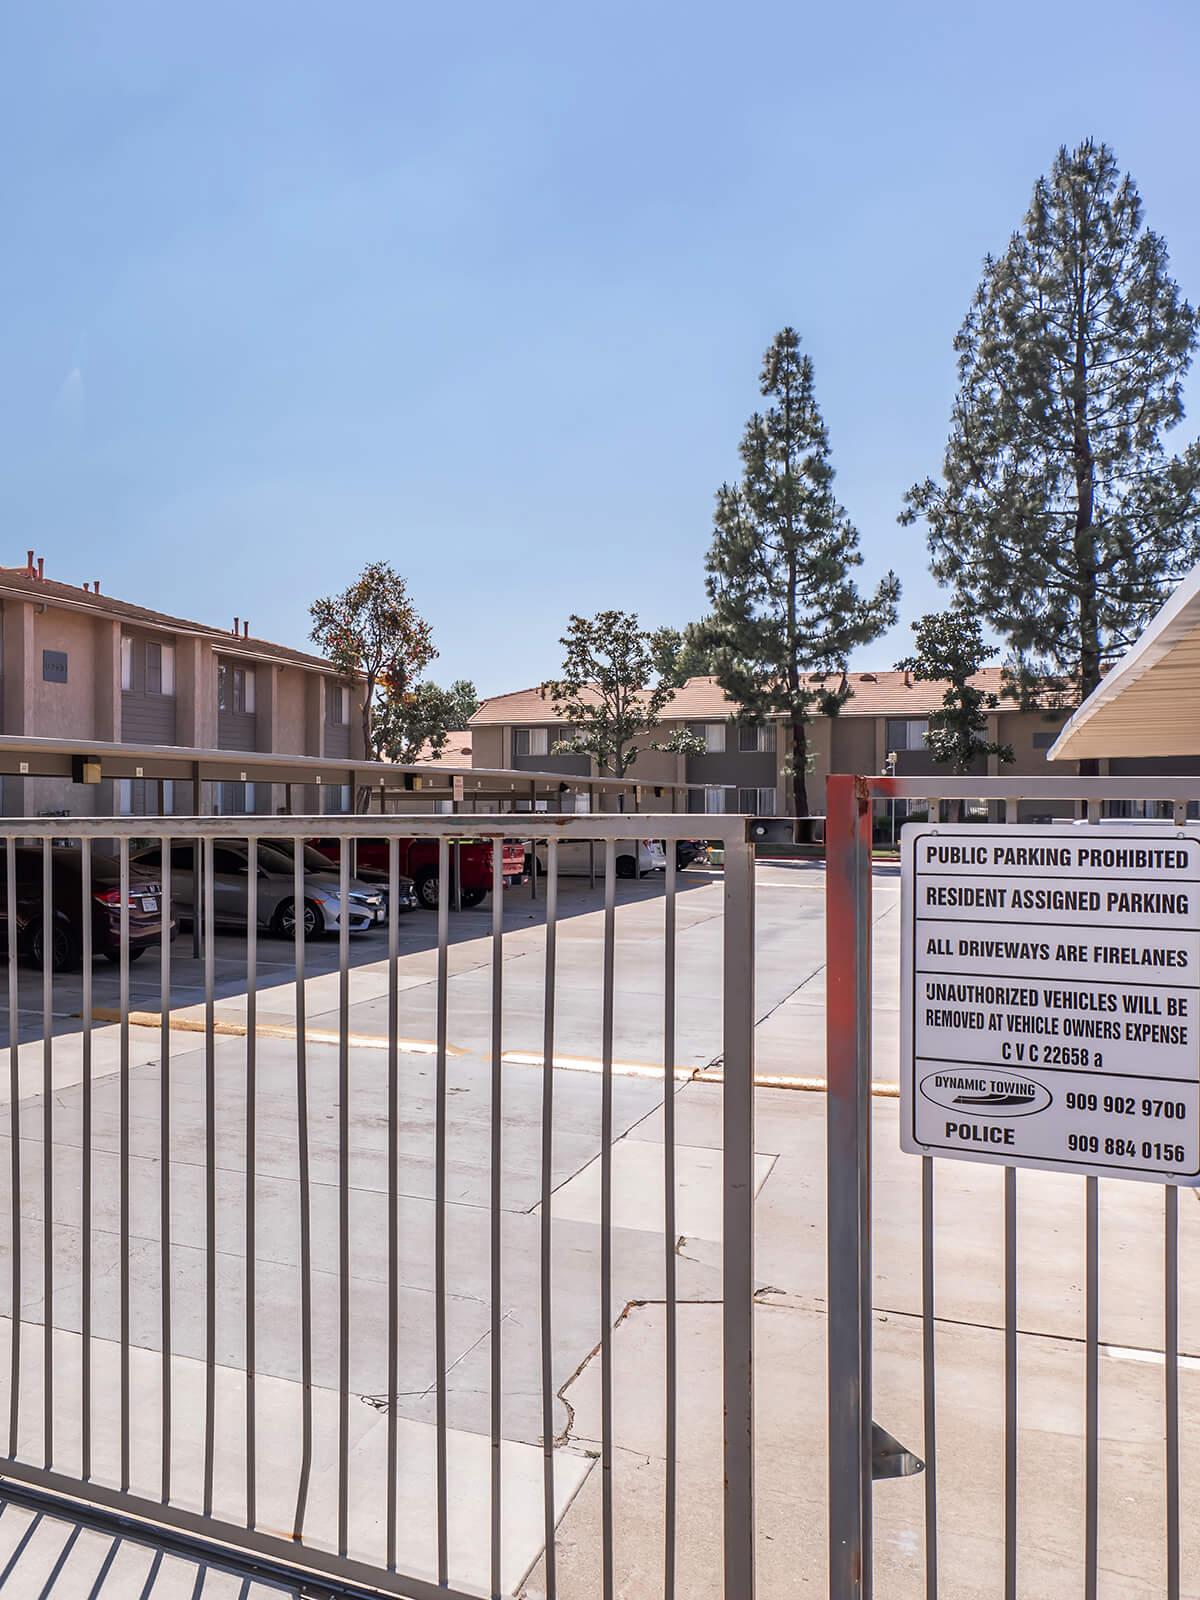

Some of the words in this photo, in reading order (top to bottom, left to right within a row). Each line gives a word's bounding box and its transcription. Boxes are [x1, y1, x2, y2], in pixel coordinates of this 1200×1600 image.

[926, 846, 988, 865] PUBLIC
[993, 847, 1071, 867] PARKING
[1078, 848, 1189, 869] PROHIBITED
[926, 886, 1007, 908] RESIDENT
[1011, 889, 1100, 911] ASSIGNED
[1106, 892, 1189, 914] PARKING
[926, 938, 953, 955] ALL
[959, 940, 1050, 960] DRIVEWAYS
[1055, 944, 1088, 962] ARE
[1093, 946, 1188, 967] FIRELANES
[926, 983, 1038, 1007] UNAUTHORIZED
[1043, 989, 1118, 1013] VEHICLES
[1122, 994, 1162, 1016] WILL
[1167, 997, 1188, 1017] BE
[926, 1008, 984, 1030] REMOVED
[988, 1013, 1004, 1031] AT
[1006, 1014, 1059, 1036] VEHICLE
[1063, 1018, 1121, 1041] OWNERS
[1125, 1022, 1188, 1046] EXPENSE
[1002, 1042, 1011, 1060] C
[1016, 1043, 1024, 1061] V
[1029, 1044, 1038, 1062] C
[1043, 1046, 1089, 1066] 22658
[1094, 1052, 1103, 1068] a
[935, 1075, 986, 1091] DYNAMIC
[990, 1080, 1036, 1096] TOWING
[1066, 1092, 1098, 1111] 909
[1103, 1096, 1136, 1115] 902
[1142, 1099, 1186, 1120] 9700
[945, 1122, 1015, 1145] POLICE
[1068, 1134, 1099, 1153] 909
[1104, 1138, 1136, 1157] 884
[1142, 1142, 1185, 1162] 0156
